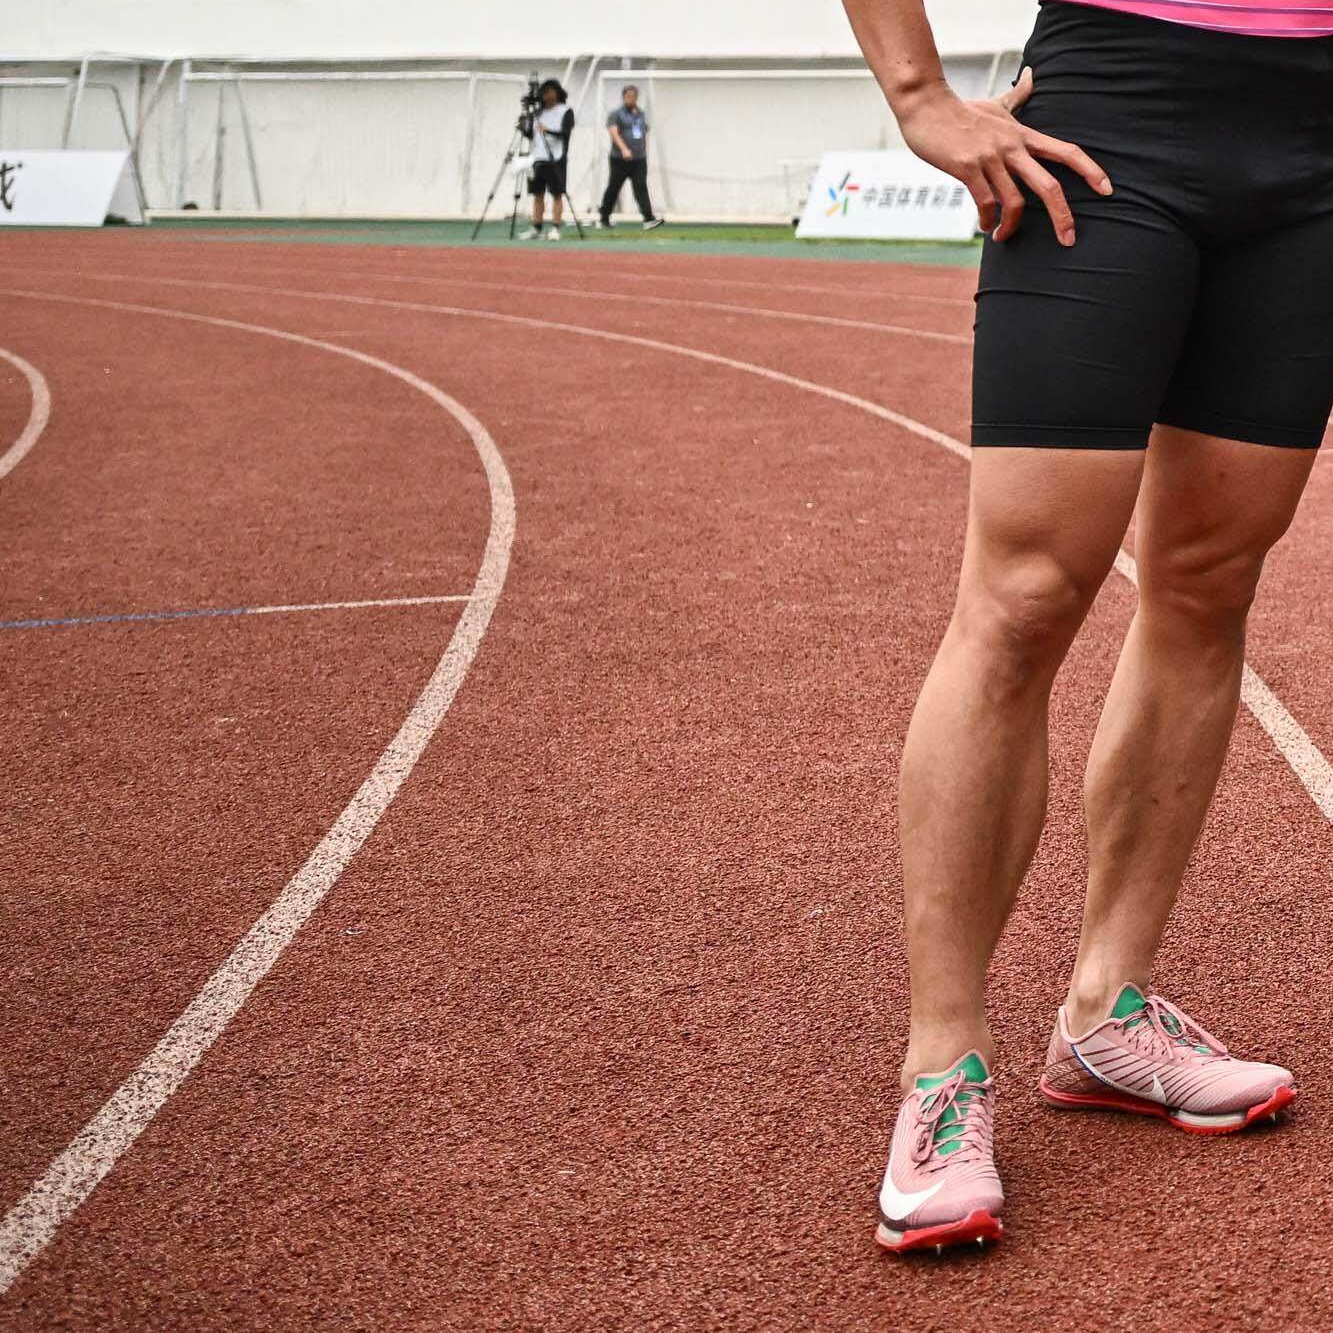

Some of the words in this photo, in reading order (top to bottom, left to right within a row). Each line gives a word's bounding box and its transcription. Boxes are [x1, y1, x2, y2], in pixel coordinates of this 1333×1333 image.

[862, 184, 967, 211] 中国体育彩票
